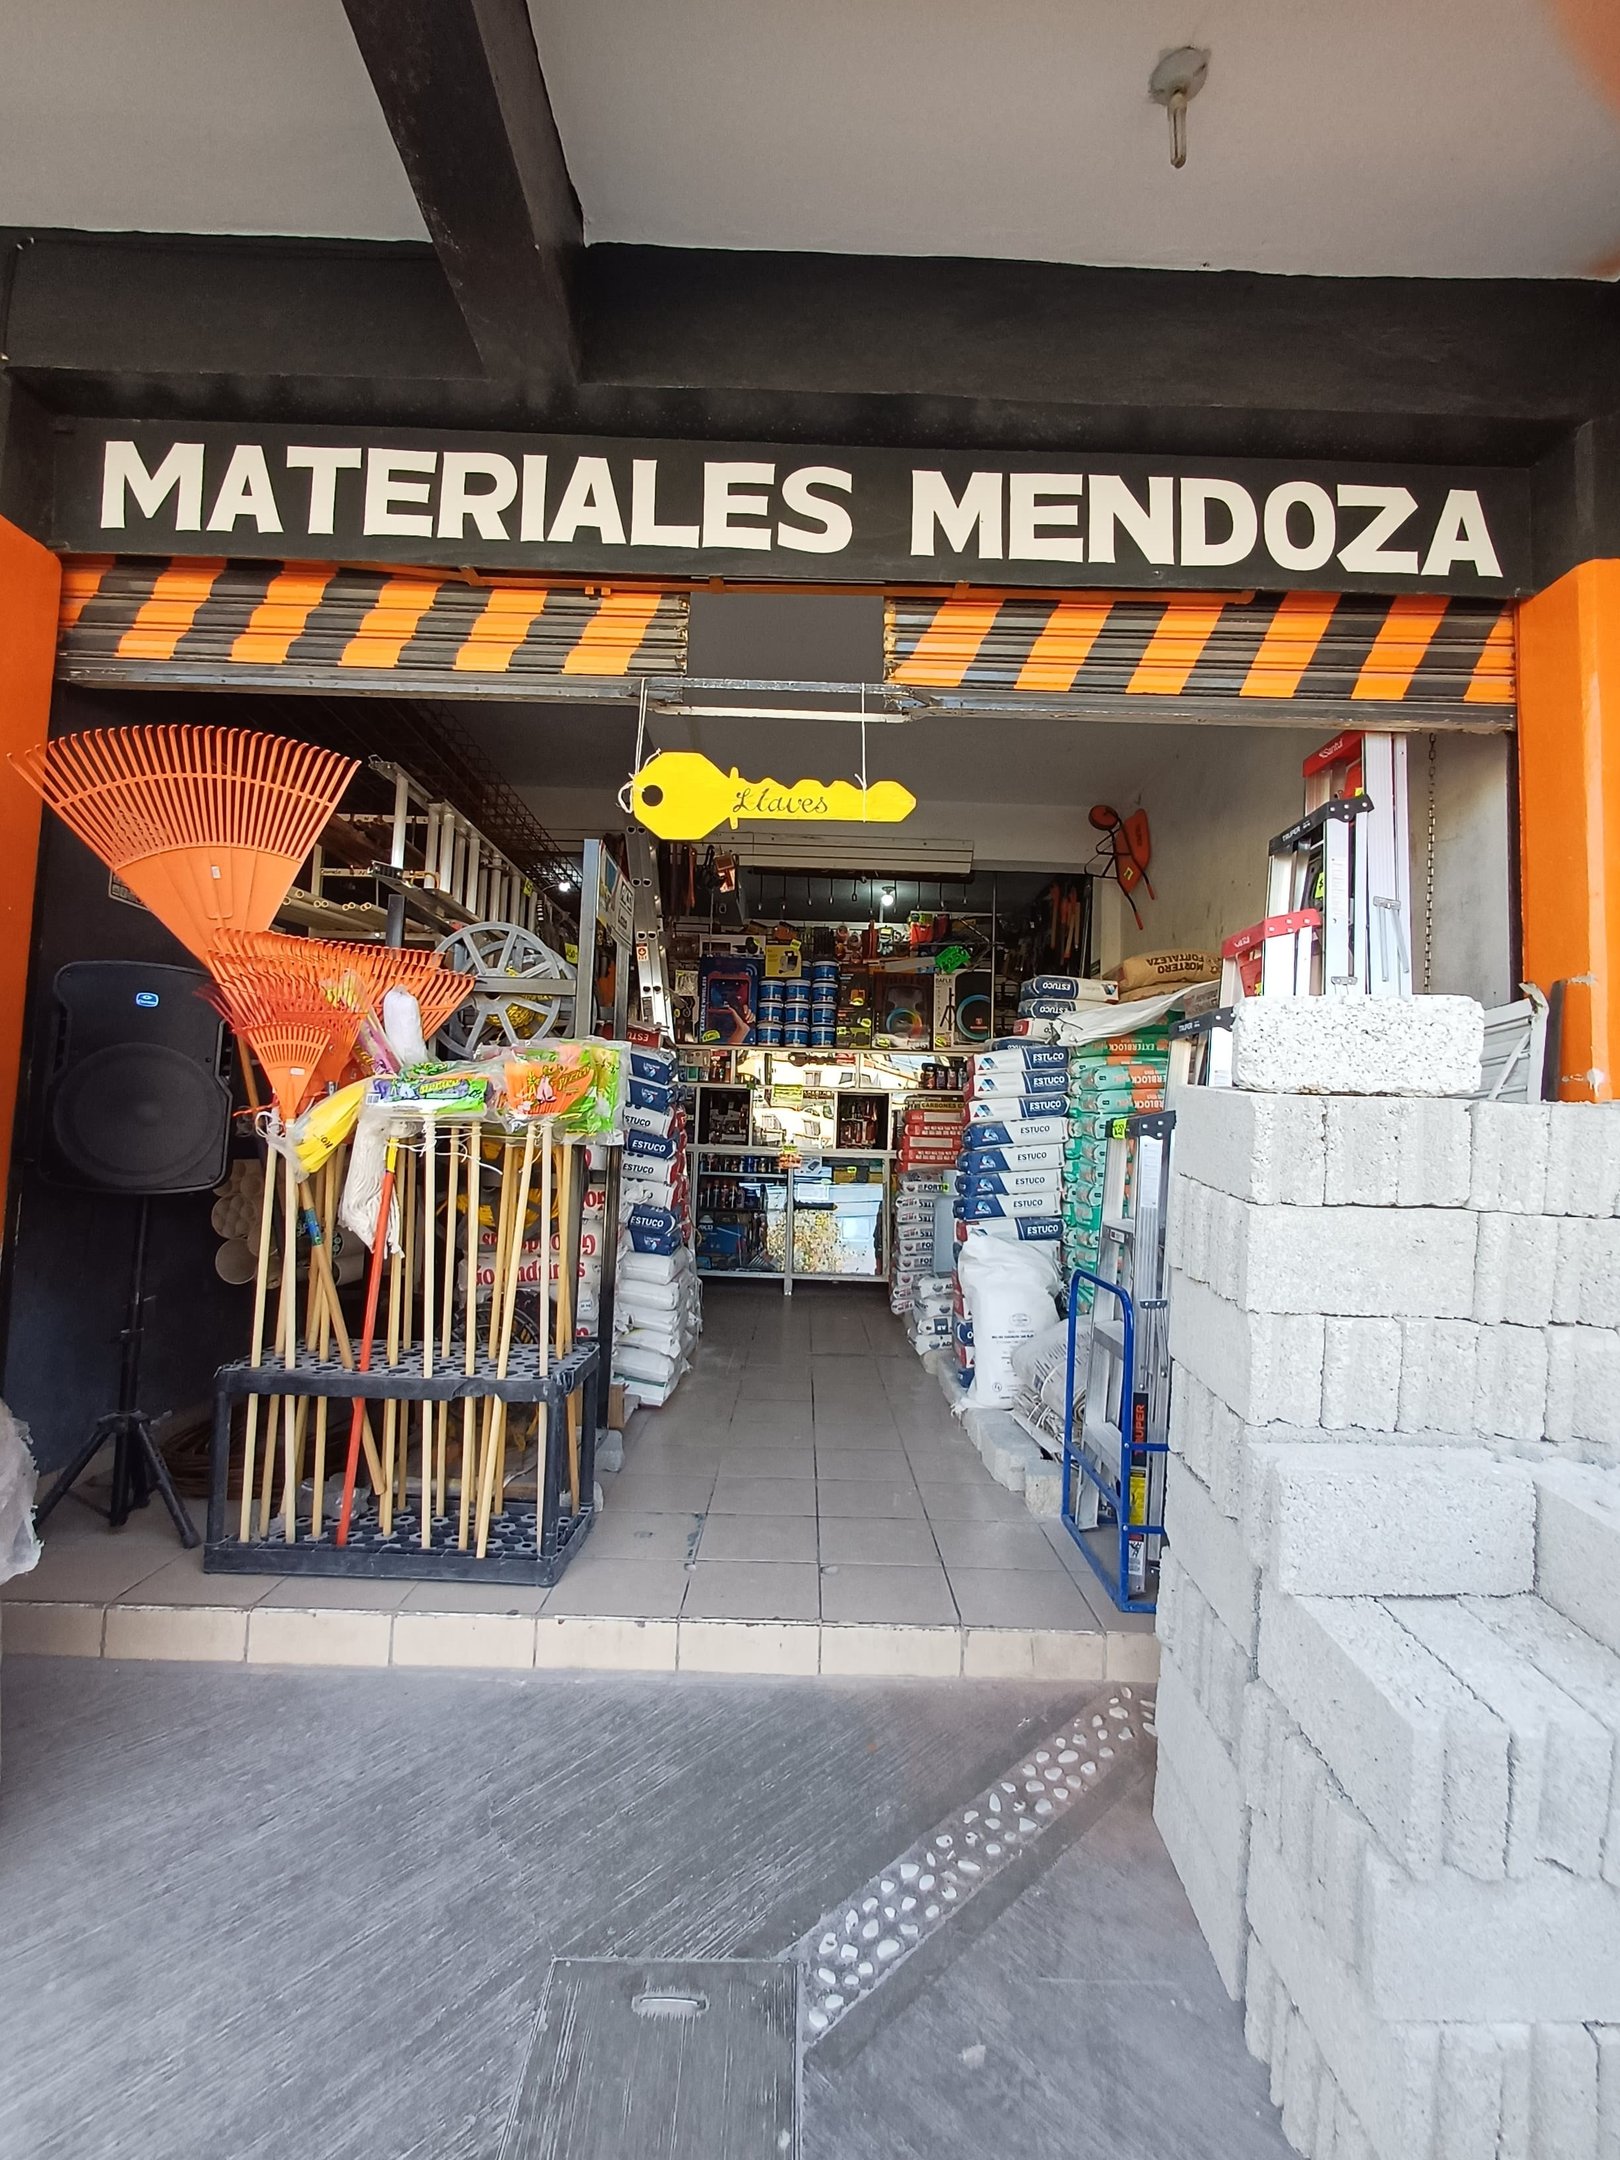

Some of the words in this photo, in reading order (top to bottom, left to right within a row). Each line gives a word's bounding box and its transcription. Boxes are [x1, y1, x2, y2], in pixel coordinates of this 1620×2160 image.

[100, 440, 854, 554] MATERIALES
[909, 469, 1504, 578] MENDOZA
[732, 787, 829, 814] Llaves
[1146, 953, 1204, 967] FORTALEZA
[1157, 962, 1204, 974] MORTERO
[1042, 981, 1071, 991] ESTUCO
[1109, 1043, 1155, 1051] EXTERBLOCK
[1033, 1052, 1065, 1061] ESTUCO
[1033, 1076, 1065, 1085] ESTUCO
[1131, 1074, 1166, 1084] ERBLOCK
[1029, 1100, 1062, 1110] ESTUCO
[1134, 1099, 1164, 1109] RBLOCK
[624, 1115, 651, 1127] STUCO
[1020, 1125, 1050, 1134] ESTUCO
[632, 1139, 666, 1153] ESTUCO
[1017, 1151, 1047, 1161] ESTUCO
[623, 1162, 654, 1174] ESTUCO
[1015, 1176, 1045, 1185] ESTUCO
[1013, 1199, 1043, 1208] ESTUCO
[630, 1215, 664, 1228] ESTUCO
[1027, 1224, 1059, 1235] ESTUCO
